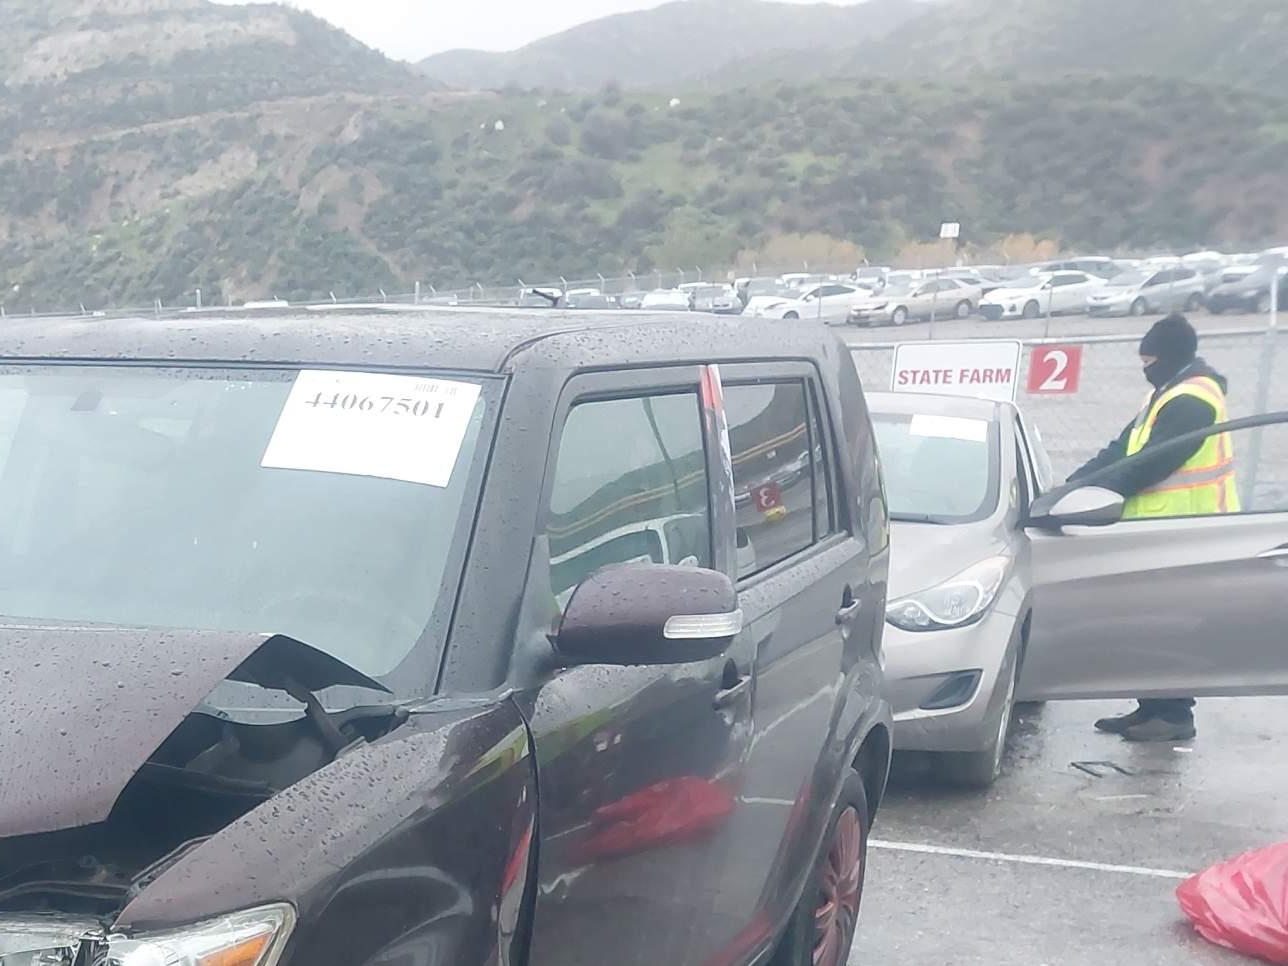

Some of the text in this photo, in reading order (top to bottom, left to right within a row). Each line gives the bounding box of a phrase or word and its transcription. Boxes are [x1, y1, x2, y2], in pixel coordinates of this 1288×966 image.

[898, 368, 1011, 384] STATE FARM
[1039, 350, 1068, 390] 2
[306, 392, 444, 418] 44067501
